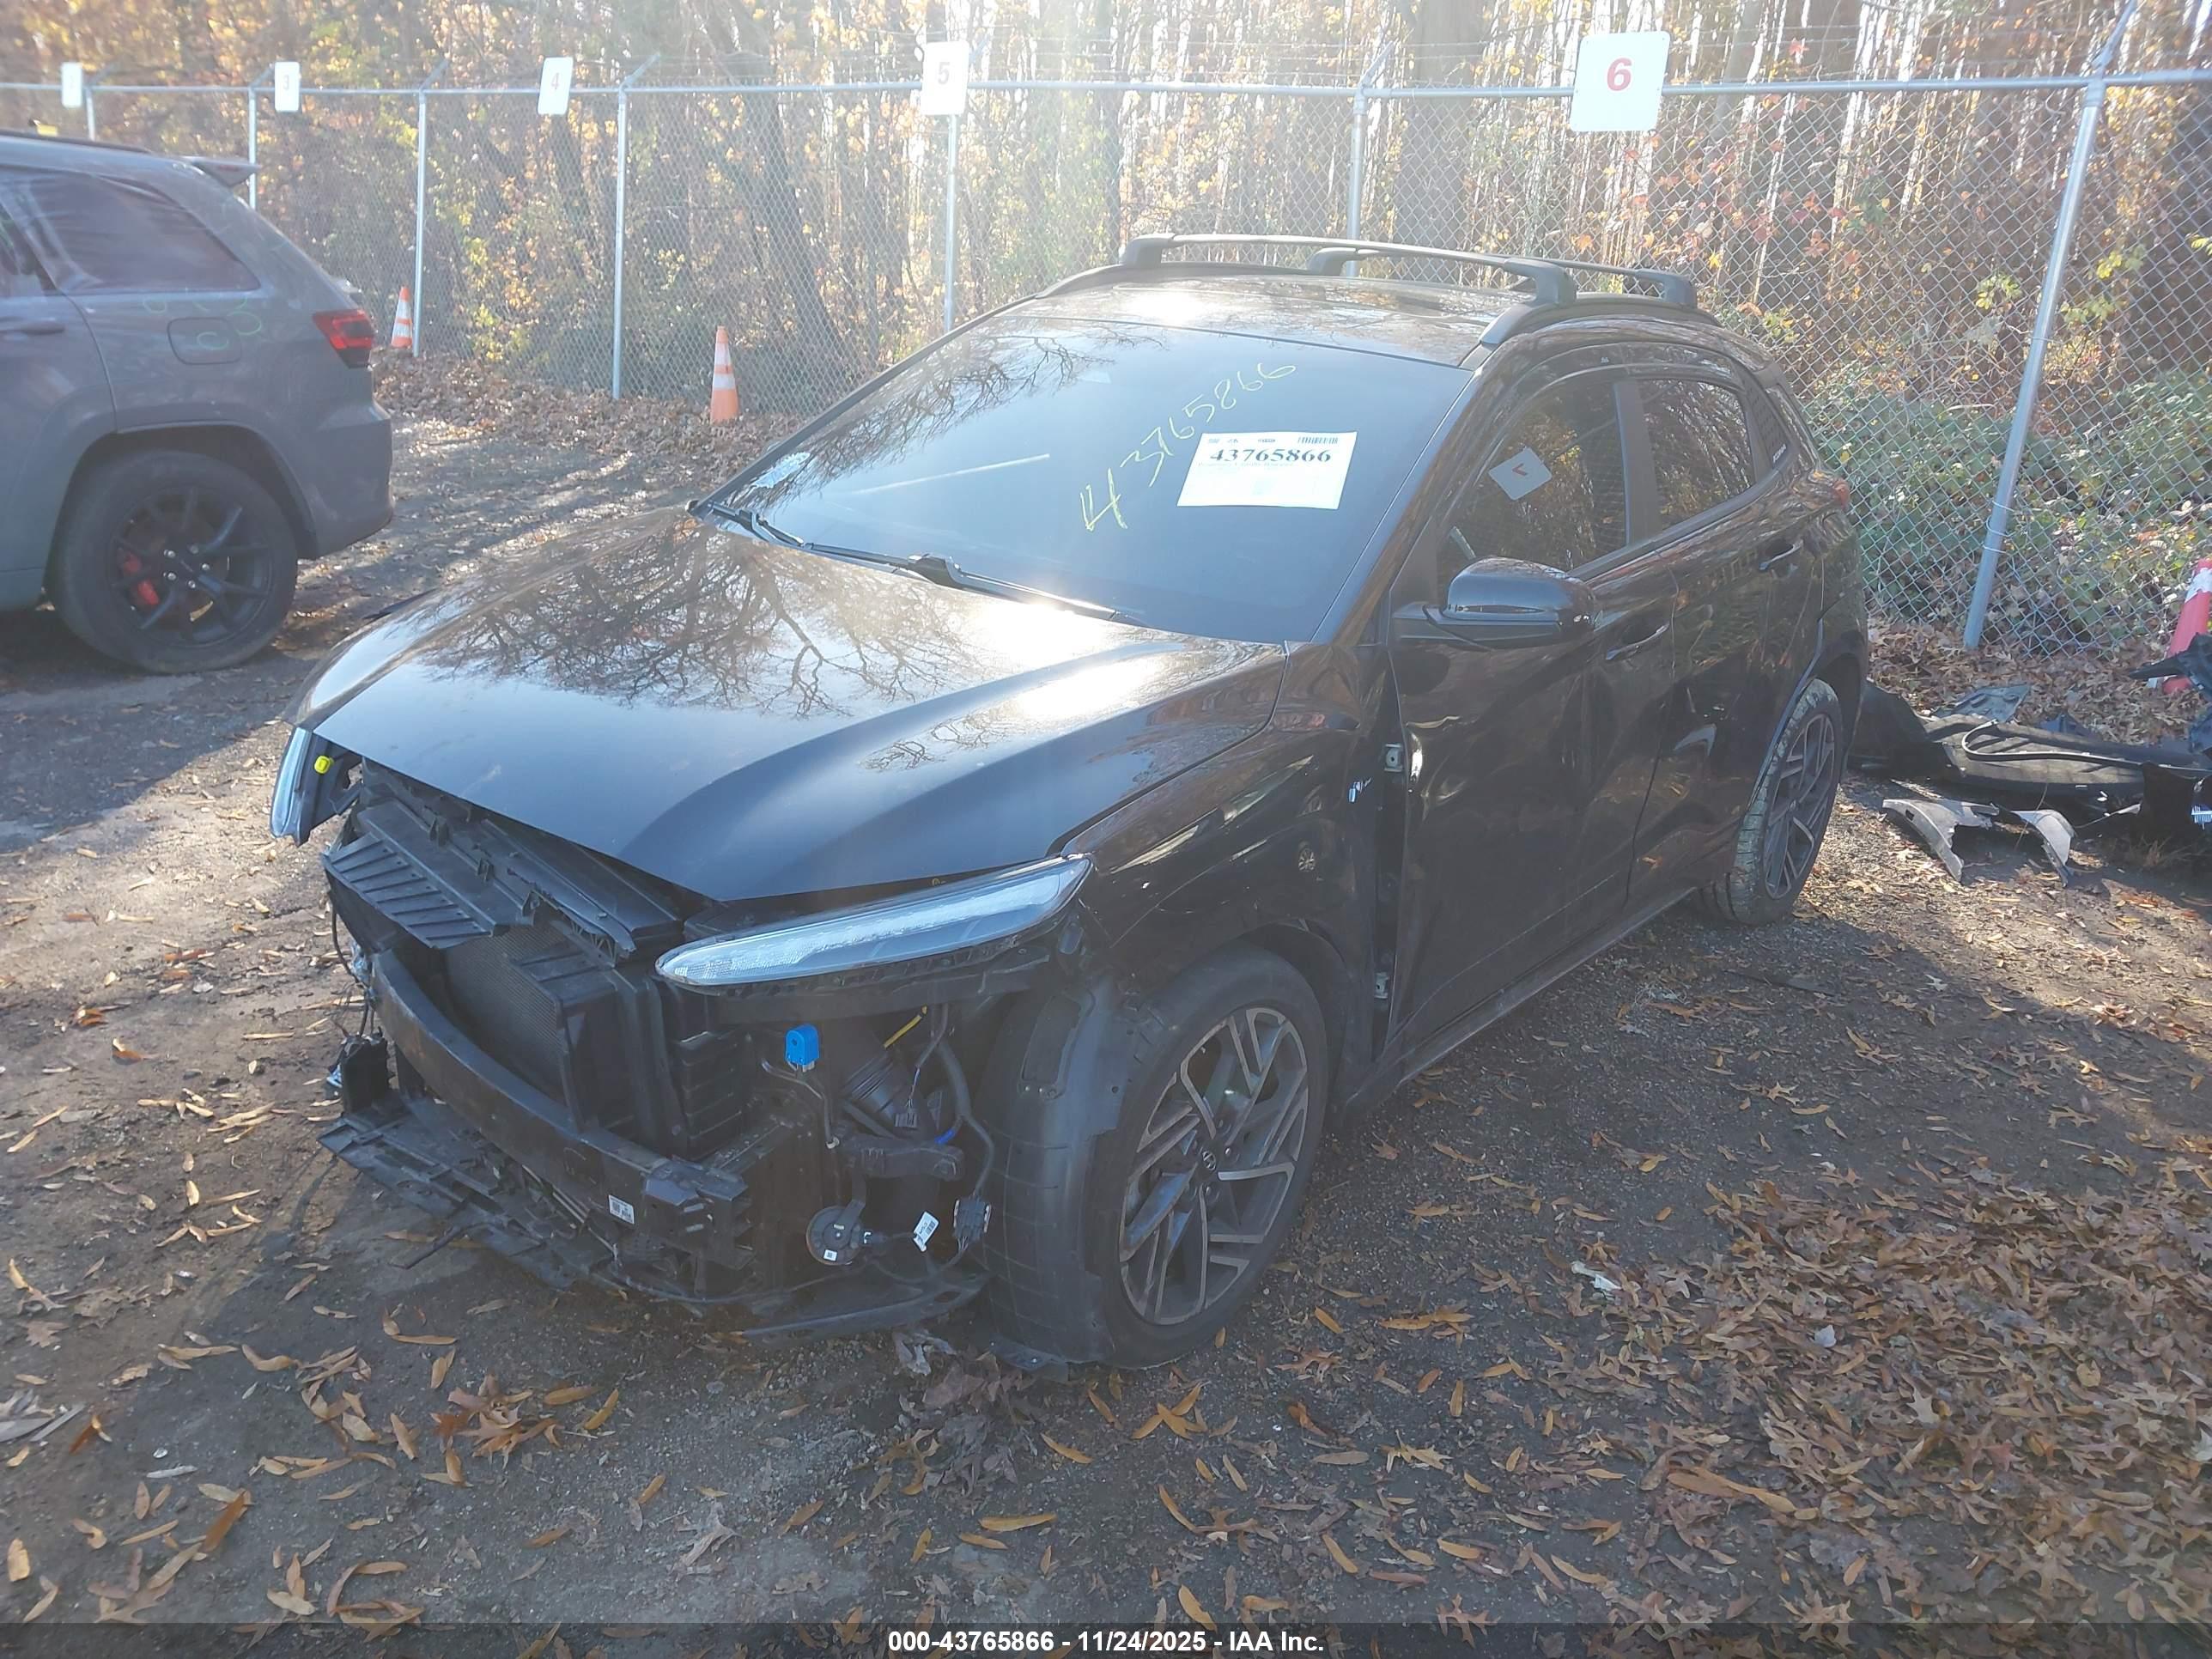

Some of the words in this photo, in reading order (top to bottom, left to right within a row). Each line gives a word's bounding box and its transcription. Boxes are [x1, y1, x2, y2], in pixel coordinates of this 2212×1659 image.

[283, 75, 290, 91] 3
[550, 72, 561, 90] 4
[938, 61, 951, 85] 5
[1606, 57, 1633, 92] 6
[1079, 362, 1297, 532] 43765866
[1209, 448, 1333, 463] 43765866
